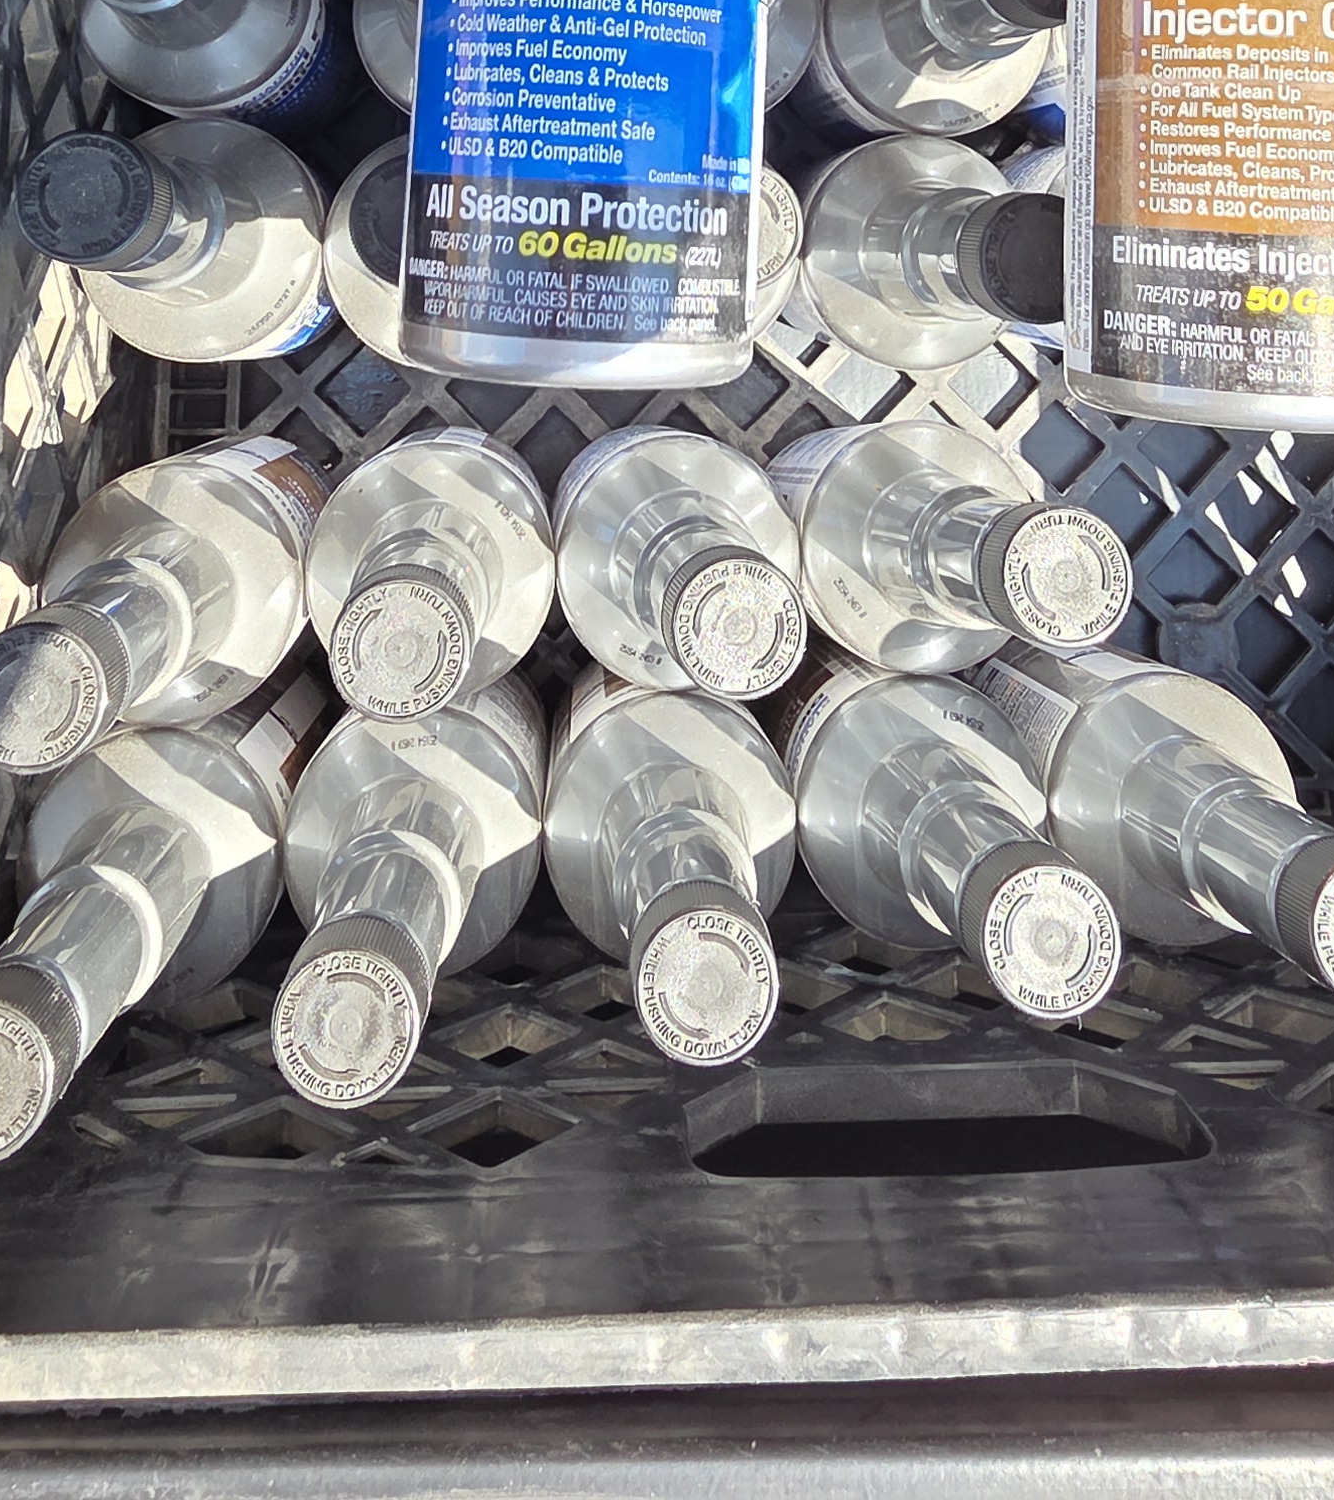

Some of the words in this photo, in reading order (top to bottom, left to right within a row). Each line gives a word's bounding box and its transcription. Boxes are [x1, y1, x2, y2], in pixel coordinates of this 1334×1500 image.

[457, 17, 483, 33] Cold
[486, 15, 546, 33] Weather
[564, 15, 630, 38] Anti-Gel
[634, 21, 706, 46] Protection
[1142, 0, 1307, 44] Injector
[455, 38, 512, 59] Improves
[516, 39, 548, 58] Fuel
[552, 40, 627, 66] Economy
[1151, 44, 1232, 61] Eliminates
[1237, 44, 1311, 64] Deposits
[454, 63, 525, 86] Lubricates,
[529, 64, 584, 85] Cleans
[604, 69, 669, 92] Protects
[1152, 64, 1223, 80] Common
[1227, 64, 1259, 80] Rail
[452, 87, 513, 107] Corrosion
[517, 88, 616, 113] Preventative
[1151, 82, 1181, 98] One
[1183, 82, 1219, 99] Tank
[1224, 82, 1273, 100] Clean
[1278, 84, 1302, 104] Up
[1151, 102, 1175, 117] For
[1177, 102, 1197, 118] All
[1203, 102, 1237, 118] Fuel
[1241, 104, 1303, 122] System
[450, 112, 499, 133] Exhaust
[502, 114, 617, 139] Aftertreatment
[621, 120, 655, 141] Safe
[1150, 122, 1219, 138] Restores
[1224, 122, 1332, 143] Performance
[449, 136, 482, 156] ULSD
[498, 139, 527, 158] B20
[530, 141, 623, 166] Compatible
[1150, 140, 1221, 160] Improves
[1225, 141, 1261, 158] Fuel
[1150, 160, 1238, 180] Lubricates,
[1243, 162, 1305, 184] Cleans,
[1149, 178, 1211, 196] Exhaust
[427, 184, 454, 219] All
[459, 184, 570, 226] Season
[580, 192, 727, 236] Protection
[1149, 197, 1193, 216] ULSD
[1213, 200, 1245, 218] B20
[430, 230, 470, 252] TREATS
[472, 233, 491, 253] UP
[494, 234, 513, 254] TO
[518, 231, 560, 258] 60
[562, 232, 678, 265] Gallons
[1113, 236, 1249, 274] Eliminates
[527, 271, 567, 290] FATAL
[1136, 284, 1189, 307] TREATS
[1217, 290, 1241, 310] TO
[1246, 285, 1290, 313] 50
[1104, 309, 1177, 338] DANGER:
[1180, 322, 1247, 344] HARMFUL
[343, 588, 387, 635] TIGHTLY
[410, 586, 444, 612] TURN
[442, 611, 460, 654] DOWN
[338, 636, 355, 684] CLOSE
[413, 659, 458, 710] PUSHING
[368, 696, 410, 714] WHILE
